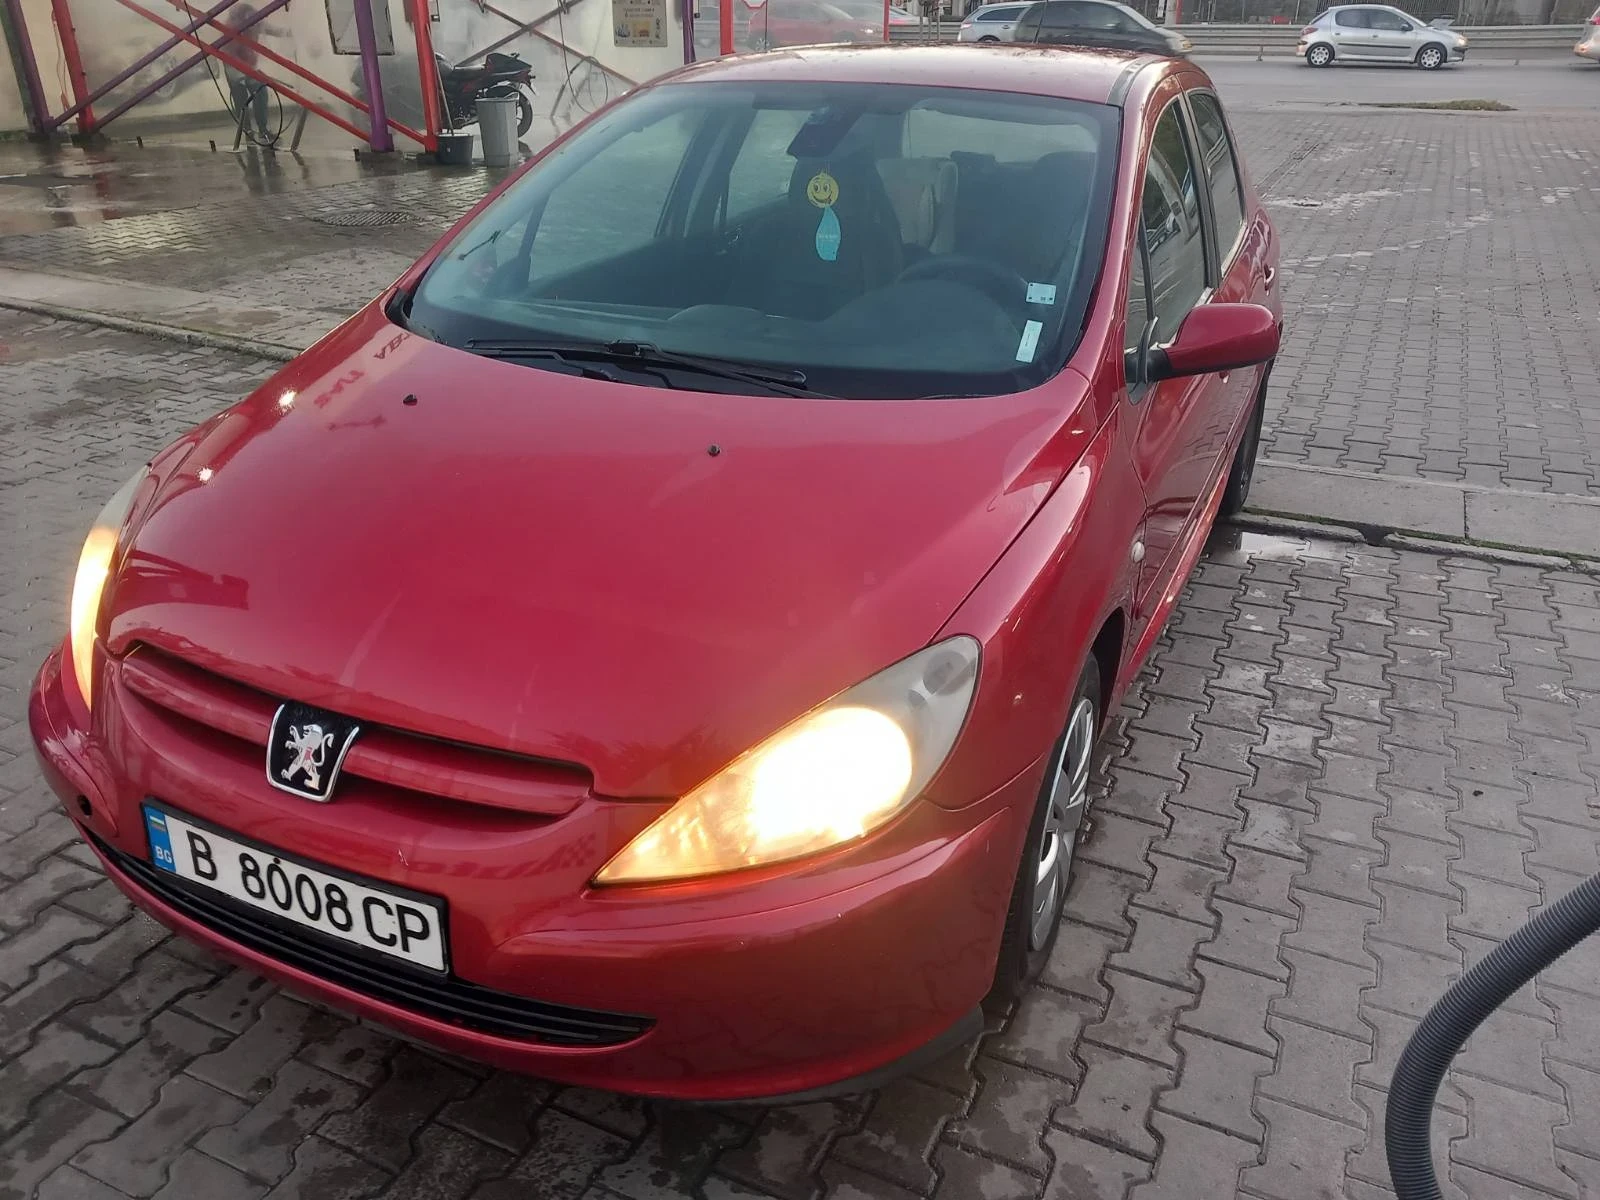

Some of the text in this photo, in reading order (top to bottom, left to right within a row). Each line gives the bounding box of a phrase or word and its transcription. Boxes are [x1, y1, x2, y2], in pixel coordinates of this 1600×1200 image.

[155, 845, 172, 864] BG
[187, 830, 430, 953] B 8008 CP
